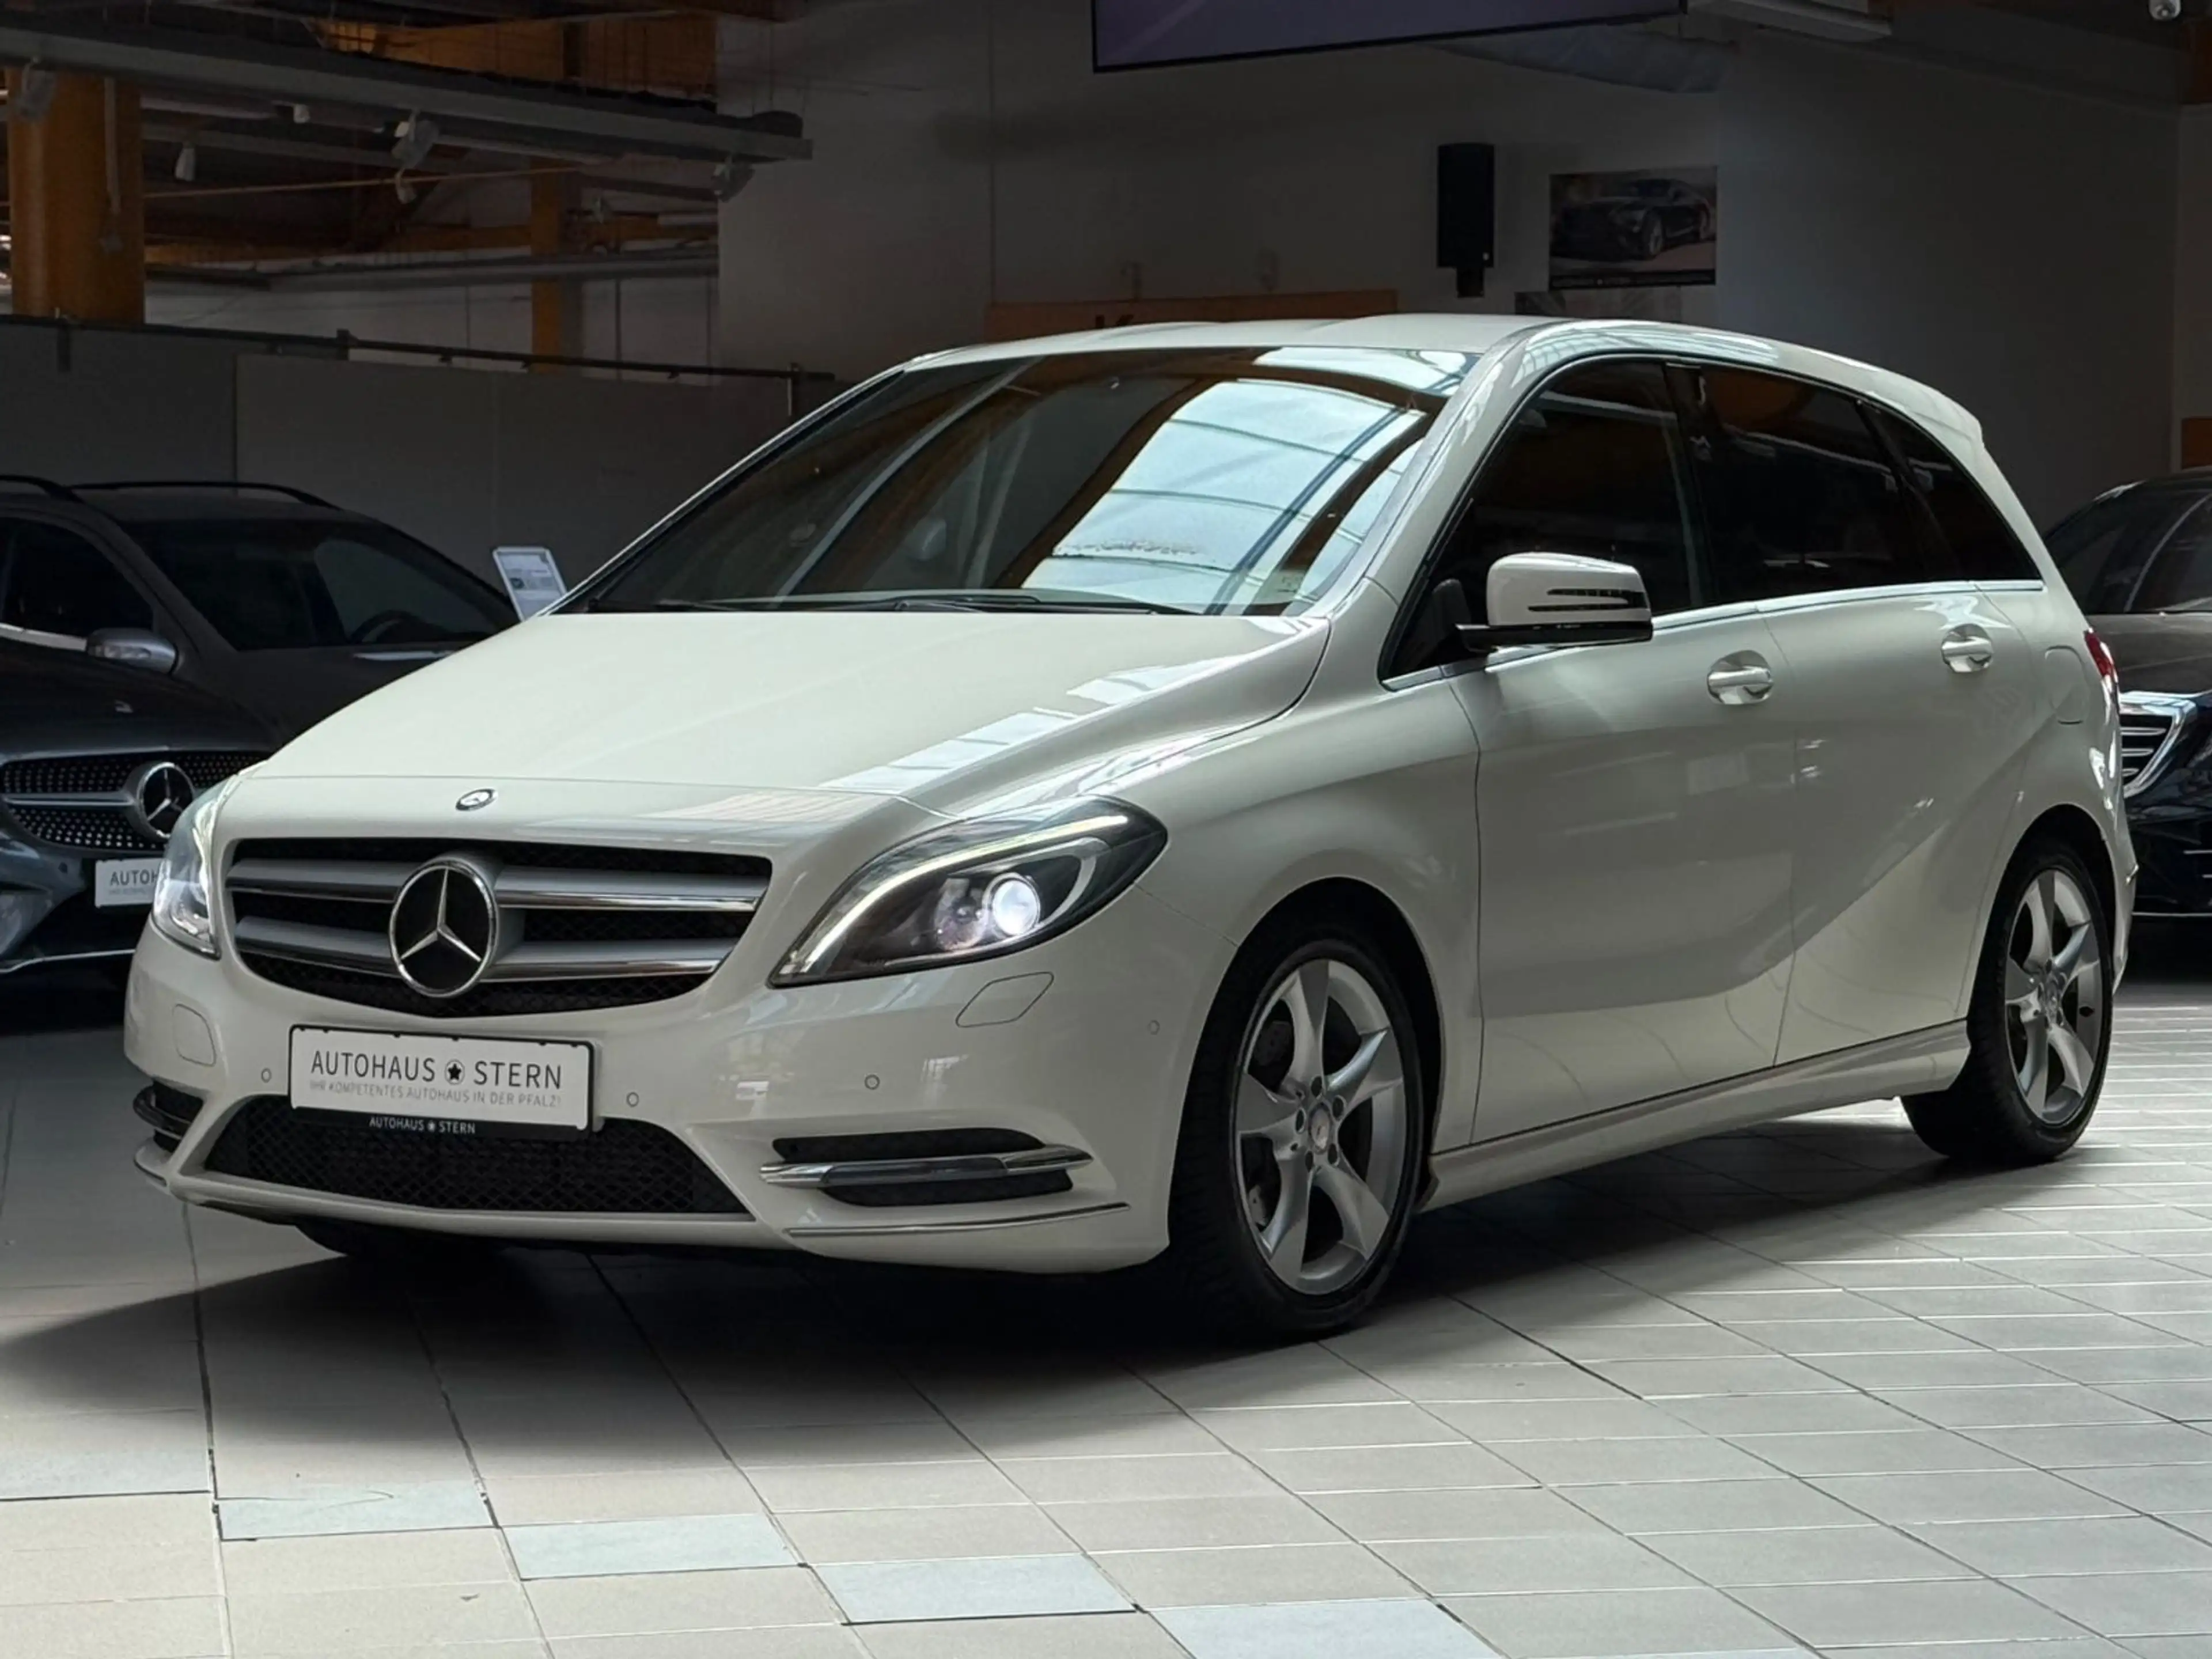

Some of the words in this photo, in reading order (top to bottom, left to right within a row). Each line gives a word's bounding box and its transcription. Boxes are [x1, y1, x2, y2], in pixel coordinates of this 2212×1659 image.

[311, 1050, 435, 1082] AUTOHAUS
[473, 1060, 562, 1089] STERN
[406, 1087, 470, 1104] AUTOHAUS
[473, 1091, 485, 1104] IN
[490, 1091, 515, 1105] DER
[369, 1116, 425, 1131] AUTOHAUS
[439, 1120, 476, 1134] STERN
